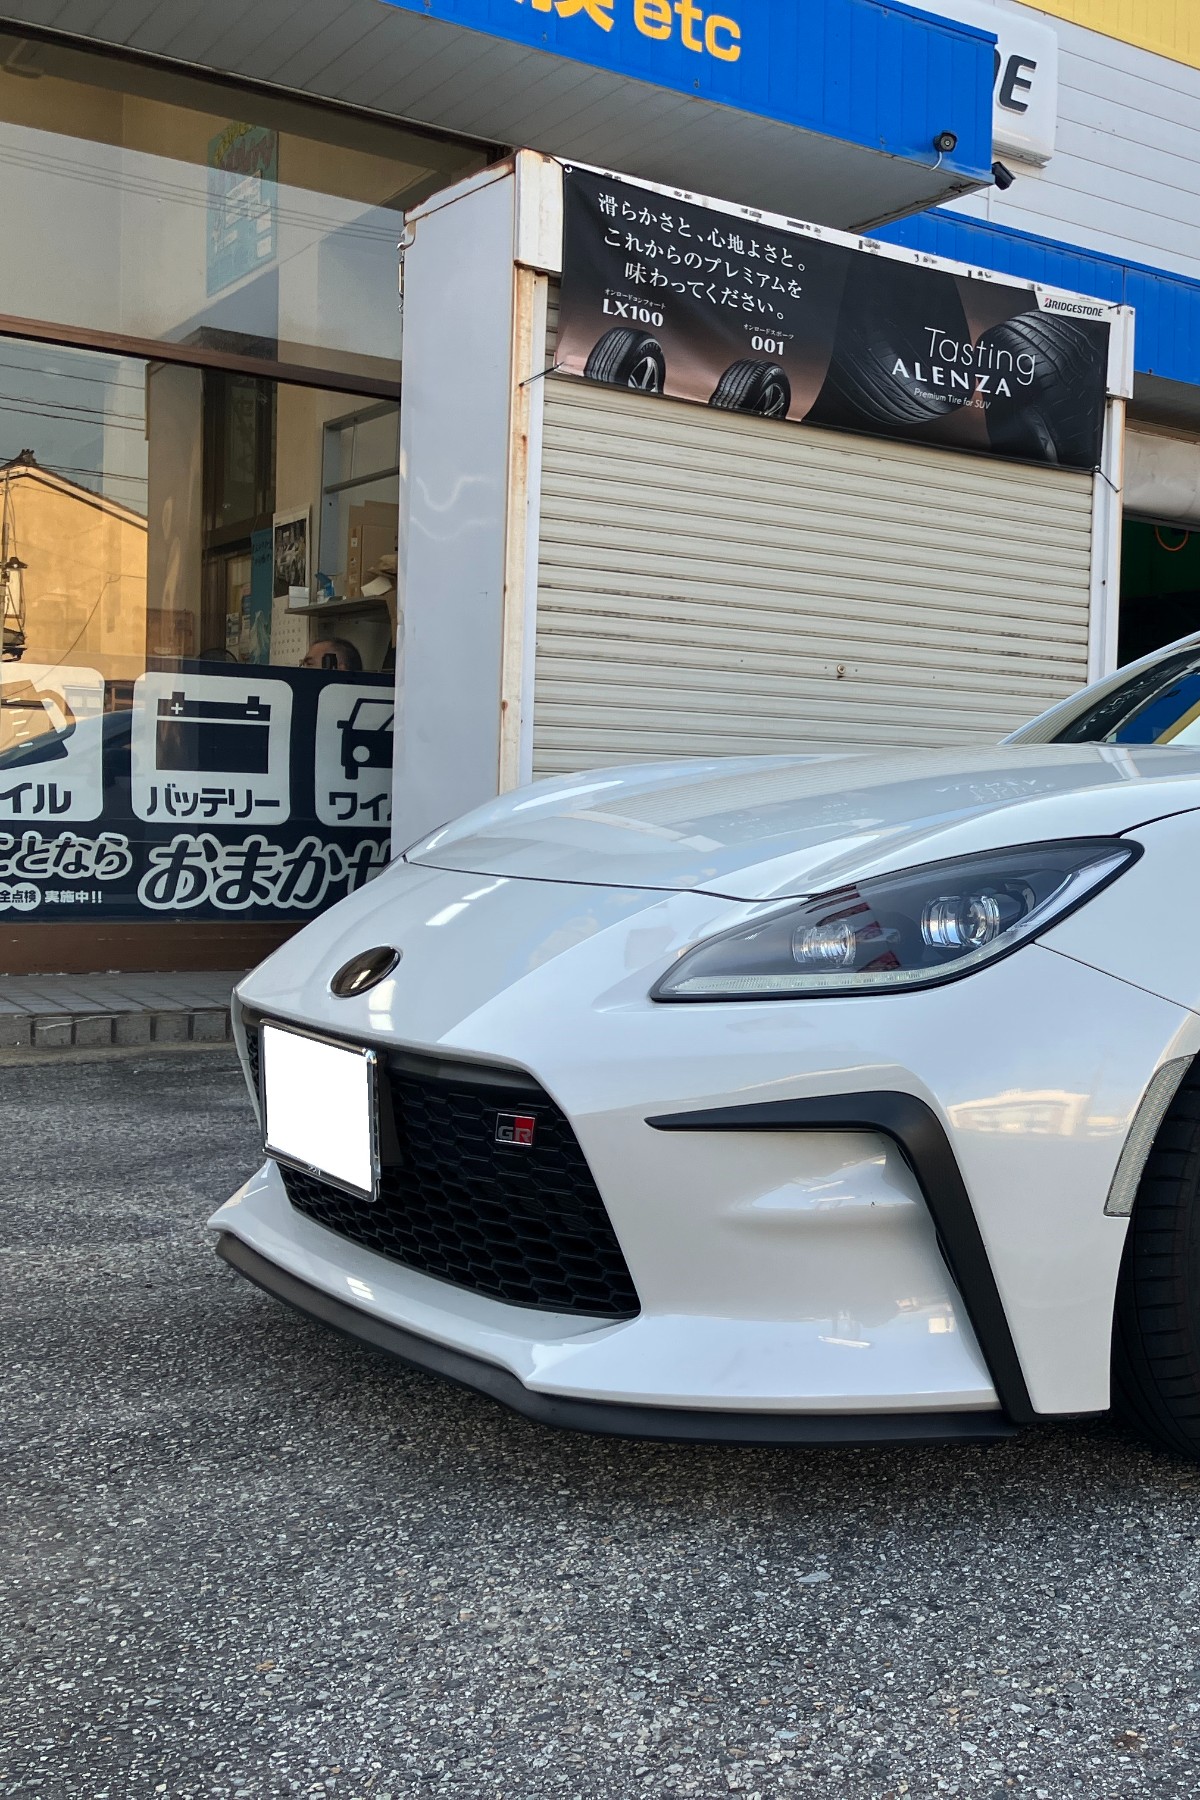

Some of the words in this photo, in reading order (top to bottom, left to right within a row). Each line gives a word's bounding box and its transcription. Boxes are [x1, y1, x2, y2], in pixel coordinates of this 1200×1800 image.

[634, 0, 741, 62] etc
[598, 193, 806, 272] 滑らかさと、心地よさと。
[604, 227, 802, 299] これからのプレミアムを
[625, 262, 784, 320] 味わってください。
[1044, 297, 1104, 317] BRIDGESTONE
[602, 298, 664, 327] LX100
[751, 335, 784, 356] 001
[924, 326, 1036, 386] Tasting
[892, 358, 1012, 398] ALENZA
[914, 387, 947, 402] Premium
[948, 394, 962, 405] Tire
[963, 396, 974, 407] for
[974, 399, 991, 410] SUV
[147, 784, 280, 818] バッテリー
[329, 792, 391, 821] ワイ
[497, 1125, 532, 1143] GR
